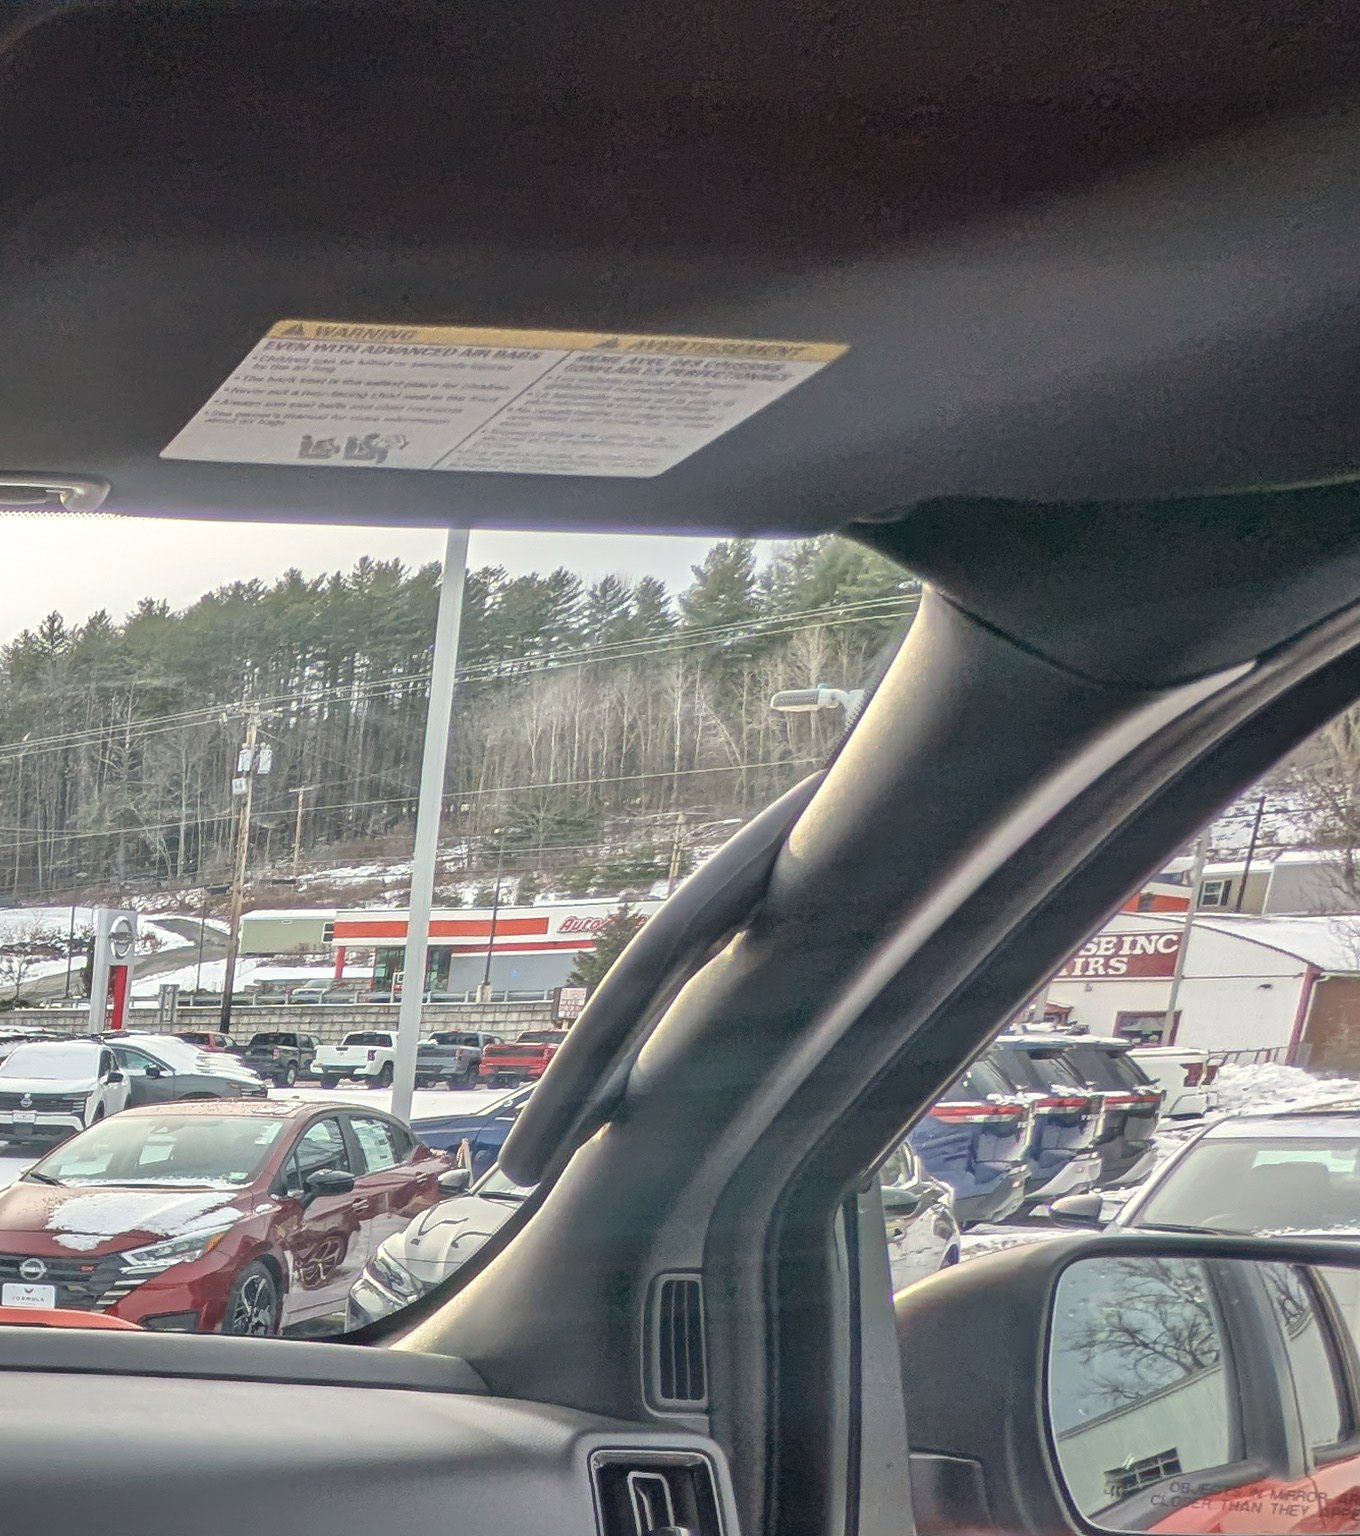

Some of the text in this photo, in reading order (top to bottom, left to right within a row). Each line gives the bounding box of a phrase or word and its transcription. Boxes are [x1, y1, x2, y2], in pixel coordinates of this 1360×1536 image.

[1119, 934, 1179, 956] INC
[1221, 1500, 1263, 1514] THAN
[1270, 1502, 1310, 1517] THEY
